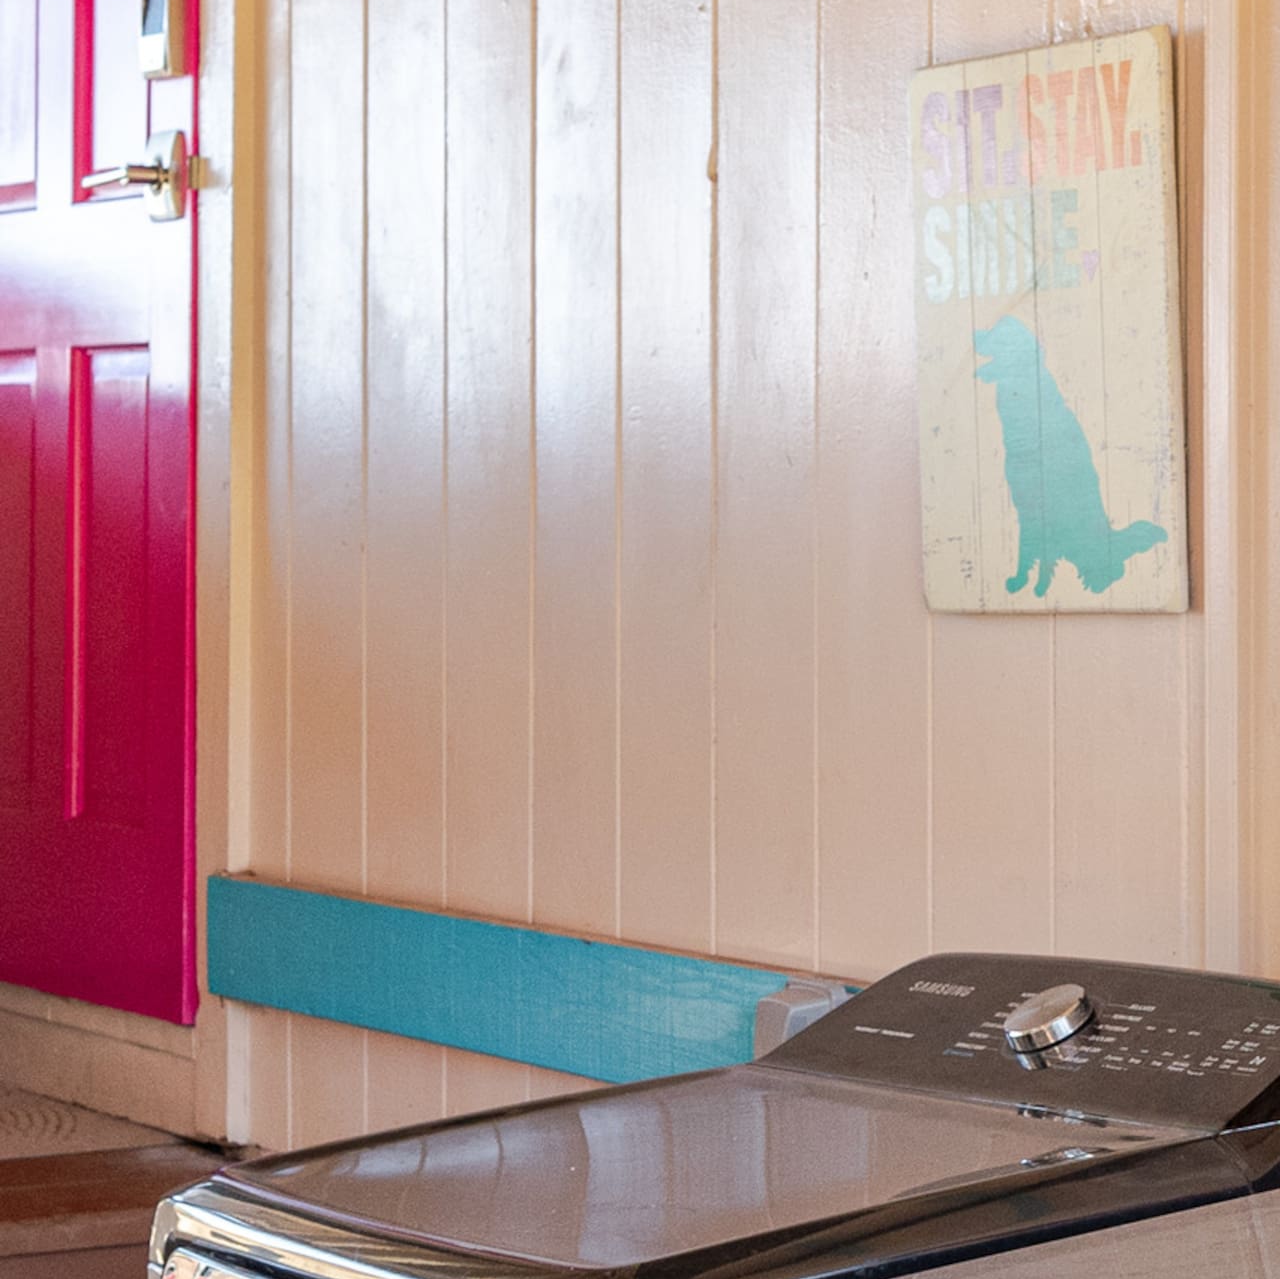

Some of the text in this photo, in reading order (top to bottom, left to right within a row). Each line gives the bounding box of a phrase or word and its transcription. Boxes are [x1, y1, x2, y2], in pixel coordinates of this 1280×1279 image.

[1017, 60, 1142, 185] STAY.
[924, 189, 1081, 304] SMILE
[908, 980, 976, 998] SAMSUNG
